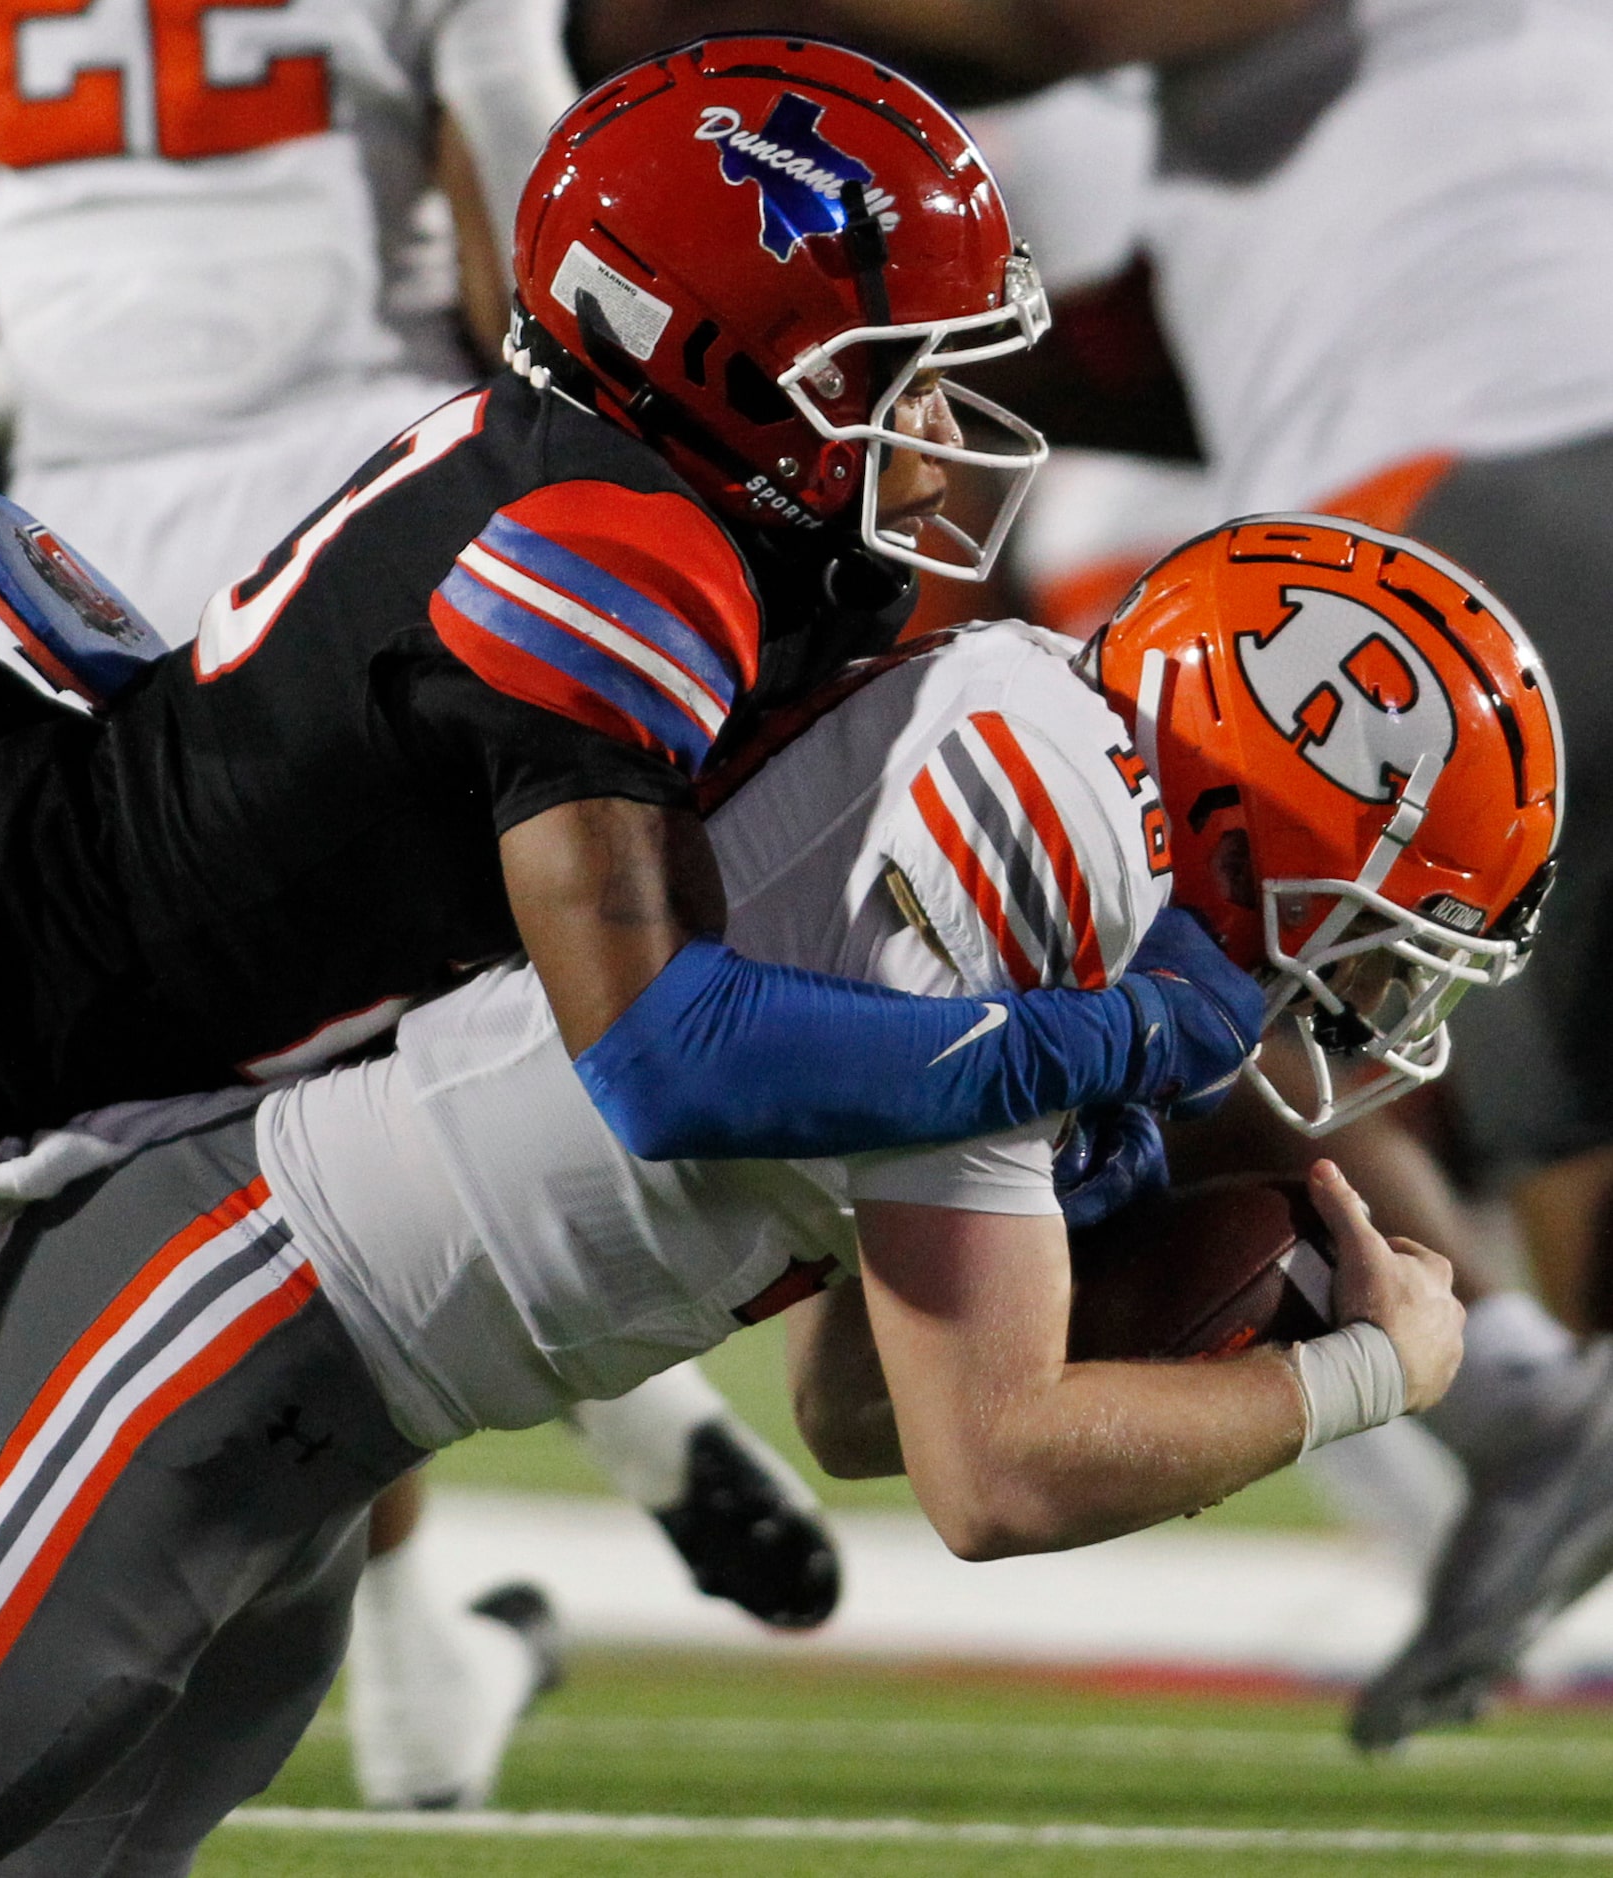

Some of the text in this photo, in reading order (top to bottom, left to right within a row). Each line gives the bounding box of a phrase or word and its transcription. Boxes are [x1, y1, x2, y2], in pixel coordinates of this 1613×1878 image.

[694, 106, 901, 232] Duncanvlle
[597, 264, 638, 297] WARNING
[1234, 582, 1458, 804] R
